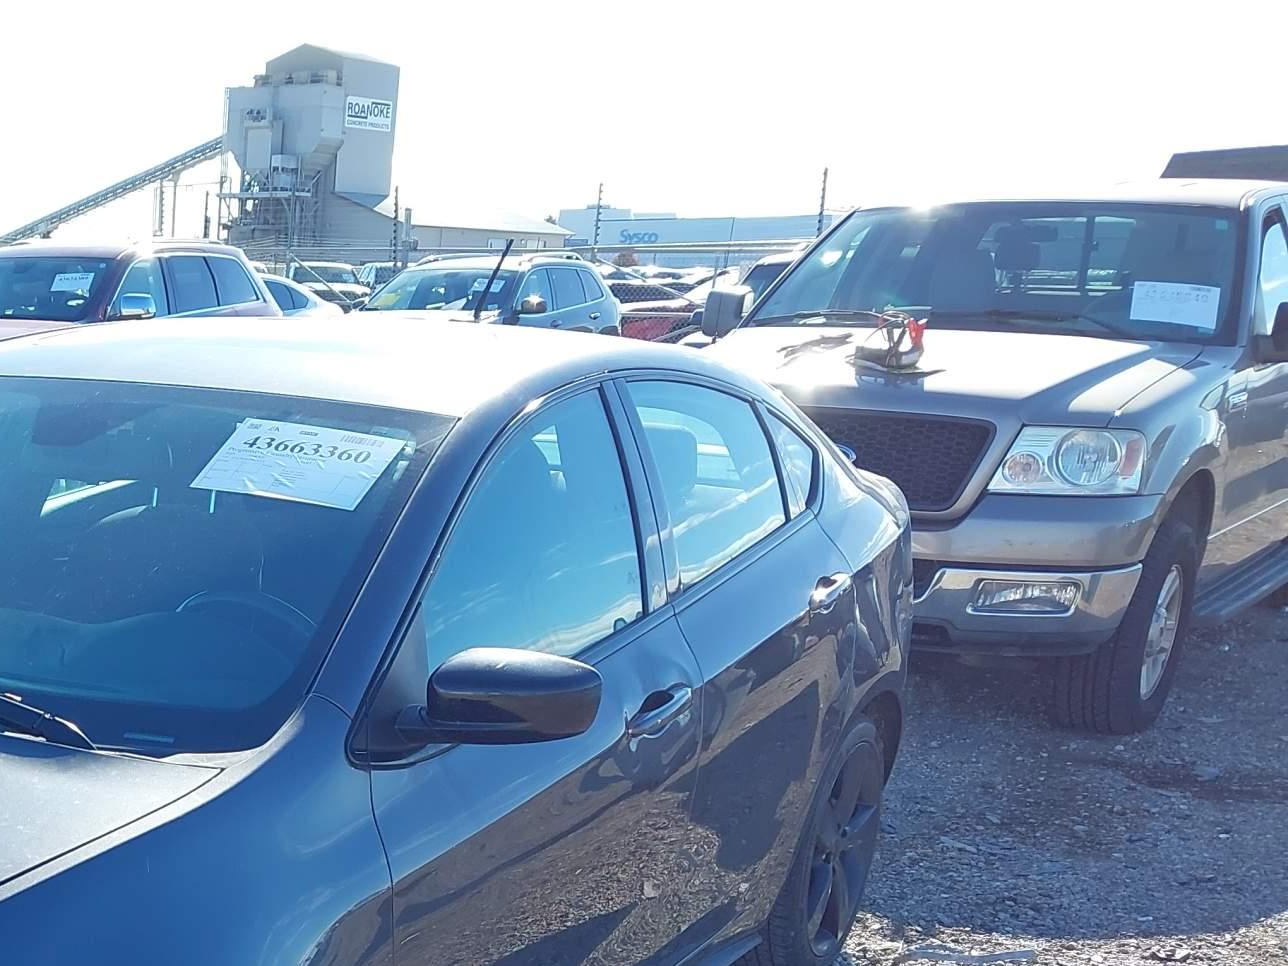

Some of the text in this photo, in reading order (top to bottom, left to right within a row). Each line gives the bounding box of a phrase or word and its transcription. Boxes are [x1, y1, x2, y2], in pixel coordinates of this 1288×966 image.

[347, 102, 391, 119] ROANOKE
[619, 229, 659, 245] Sysco
[243, 436, 371, 464] 43663360
